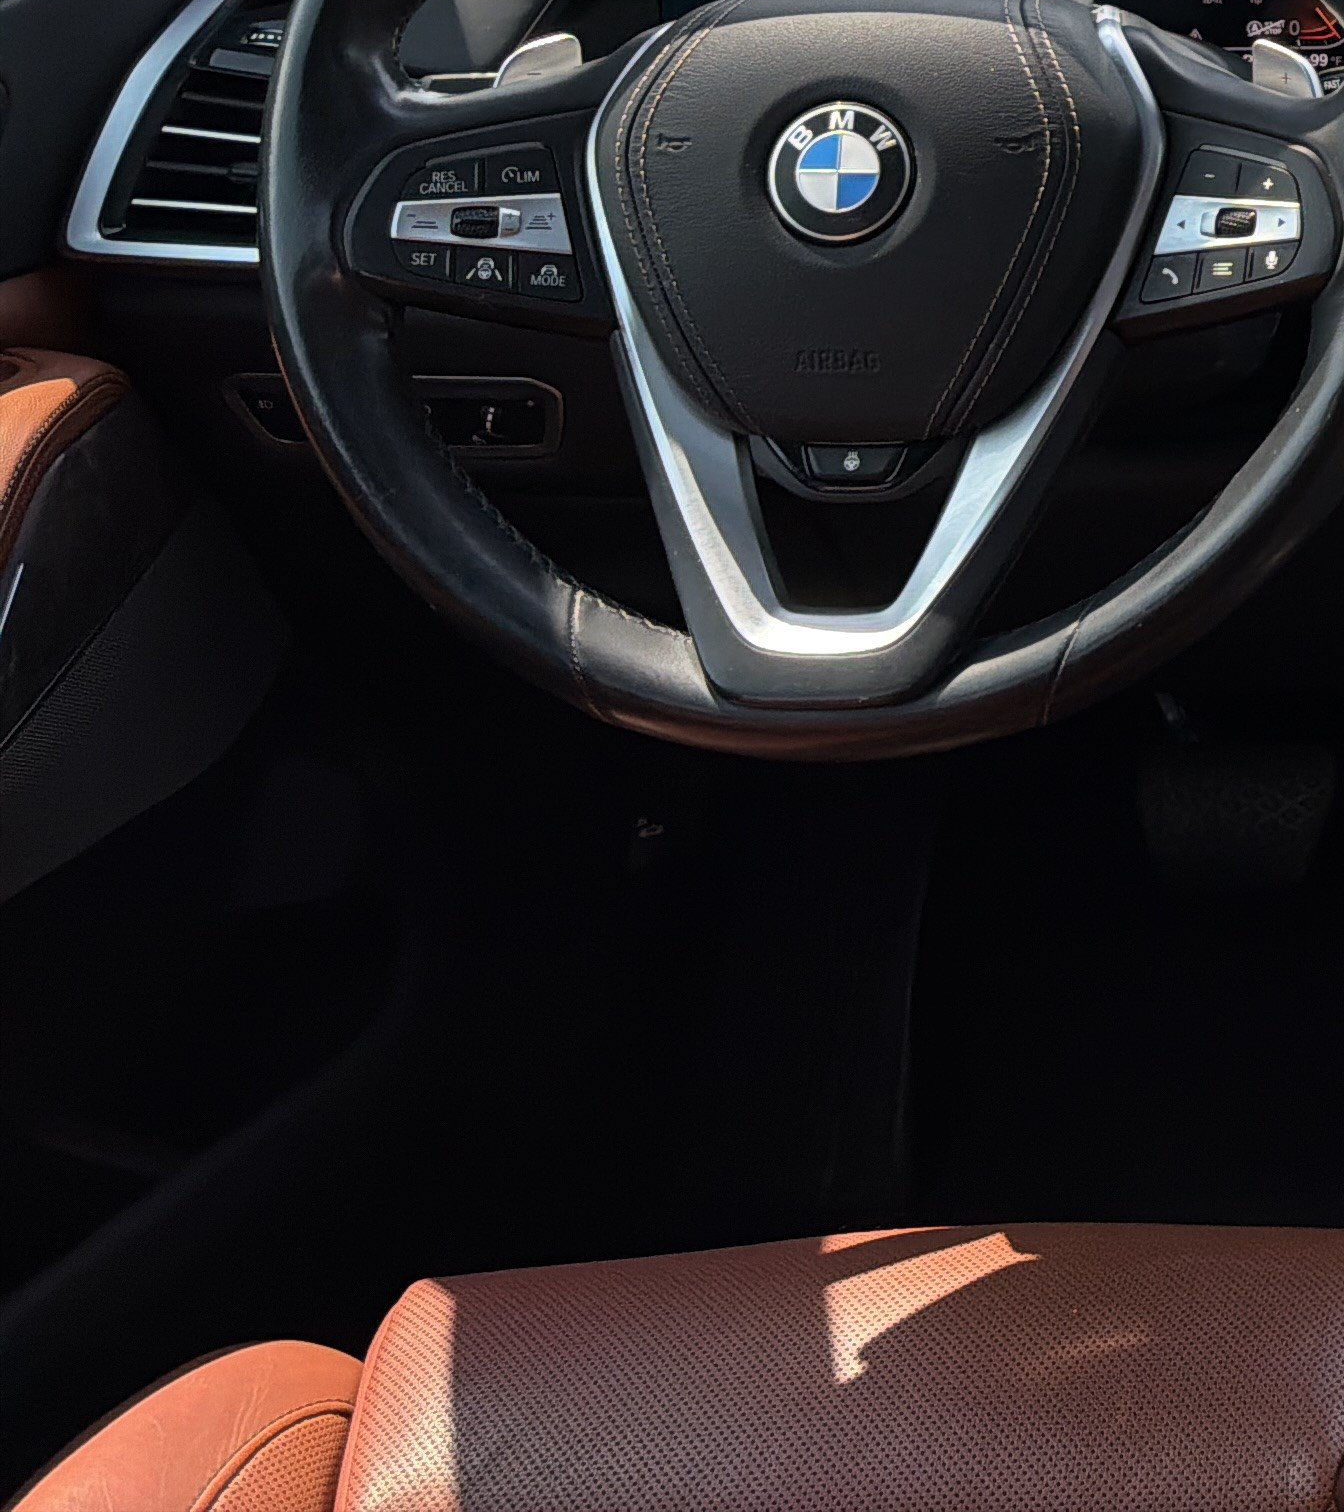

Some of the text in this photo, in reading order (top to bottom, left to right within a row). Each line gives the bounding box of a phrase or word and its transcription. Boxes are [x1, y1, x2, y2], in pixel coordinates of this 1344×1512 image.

[787, 109, 898, 152] BMW
[432, 170, 456, 183] RES
[517, 170, 541, 184] LIM
[419, 180, 469, 195] CANCEL
[411, 252, 437, 266] SET
[530, 274, 567, 287] MODE
[795, 348, 882, 373] AIRBAG
